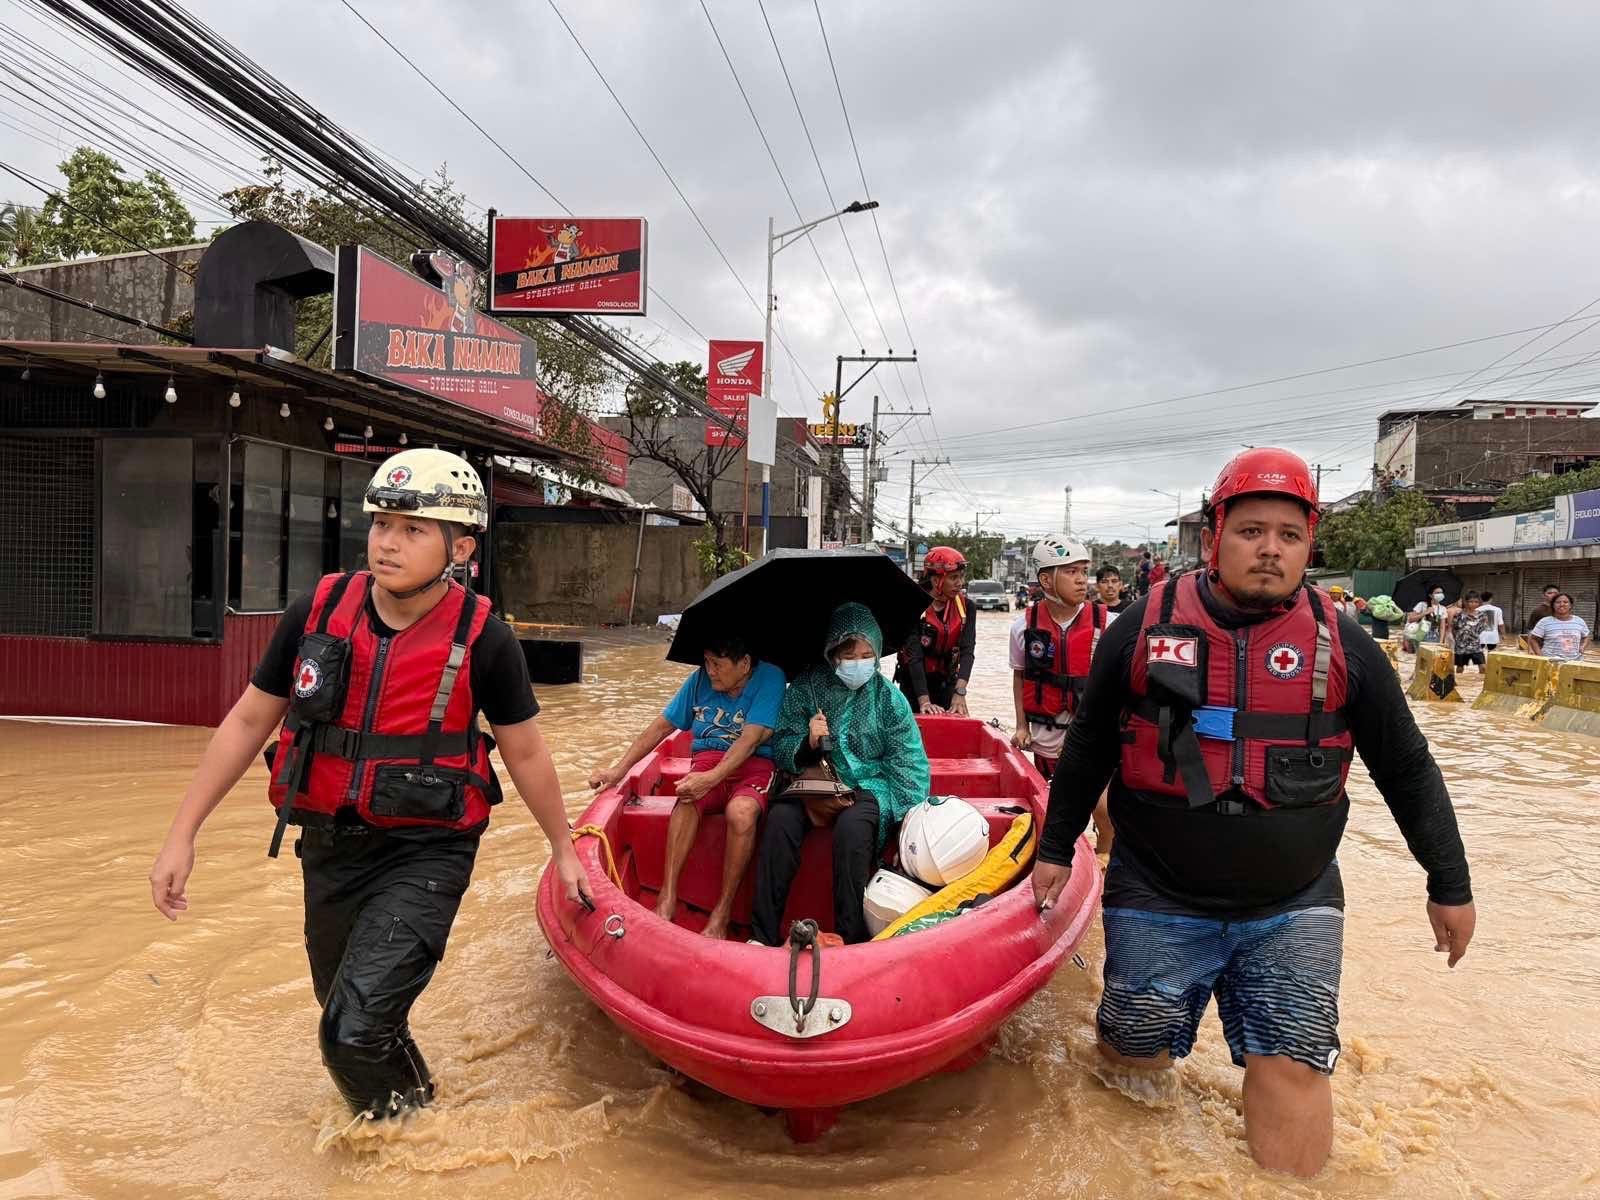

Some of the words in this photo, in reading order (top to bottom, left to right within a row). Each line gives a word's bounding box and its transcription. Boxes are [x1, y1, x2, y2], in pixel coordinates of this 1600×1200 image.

[516, 266, 556, 289] BAKA
[560, 254, 620, 280] NAMAN
[525, 283, 575, 300] STREETSIDE
[579, 279, 602, 291] GRILL
[597, 300, 638, 308] CONSOLACION
[386, 328, 446, 370] BAKA
[452, 335, 522, 375] NAMAN
[429, 376, 476, 393] STREETSIDE
[479, 380, 498, 394] GRILL
[503, 406, 535, 426] CONSOLACION
